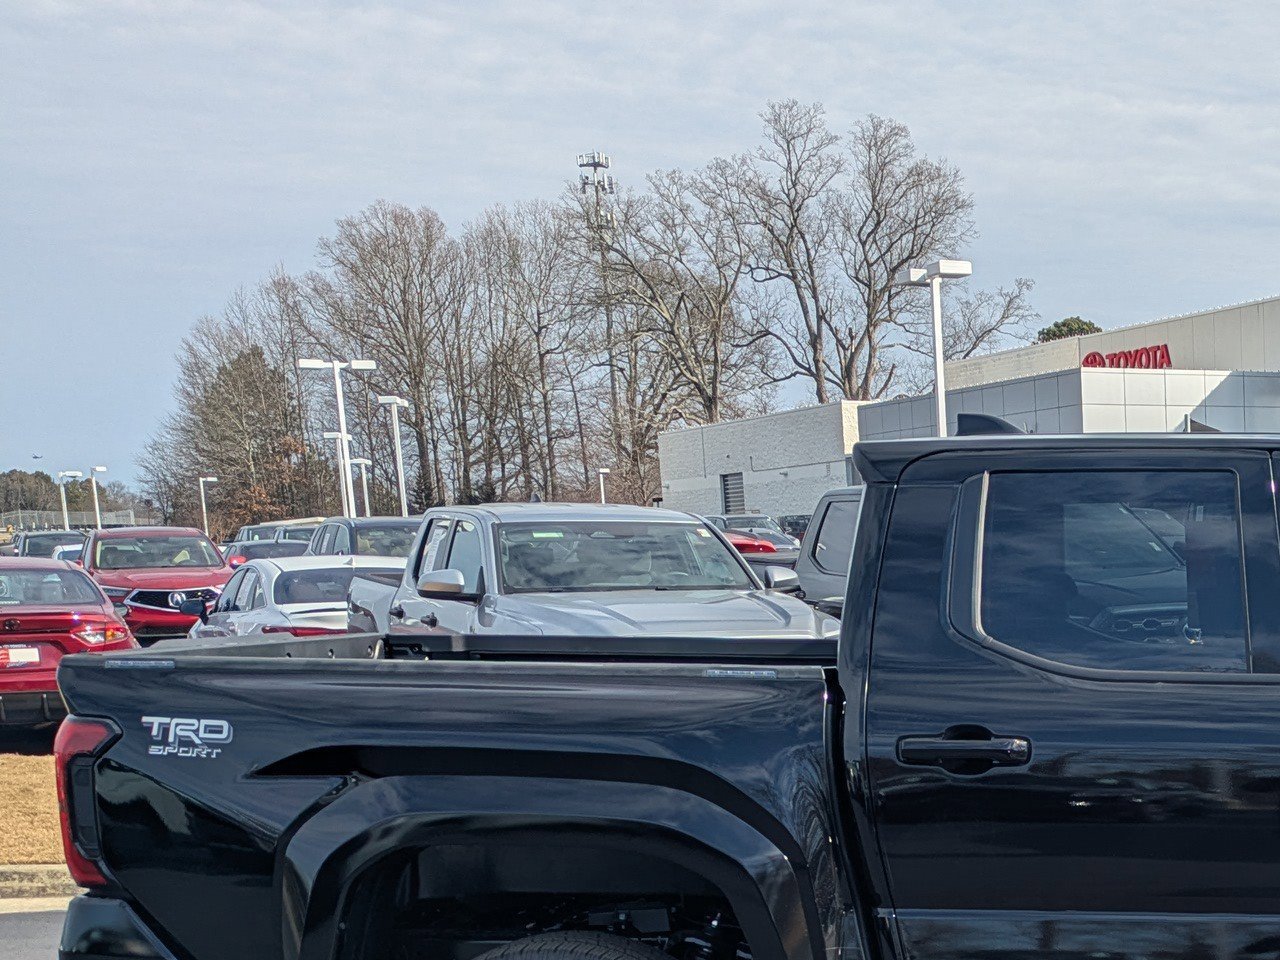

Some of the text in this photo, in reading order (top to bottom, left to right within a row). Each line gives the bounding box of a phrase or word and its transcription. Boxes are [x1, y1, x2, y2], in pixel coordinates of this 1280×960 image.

[1105, 344, 1172, 369] TOYOTA
[141, 716, 233, 744] TRD
[148, 745, 222, 758] SPORT
